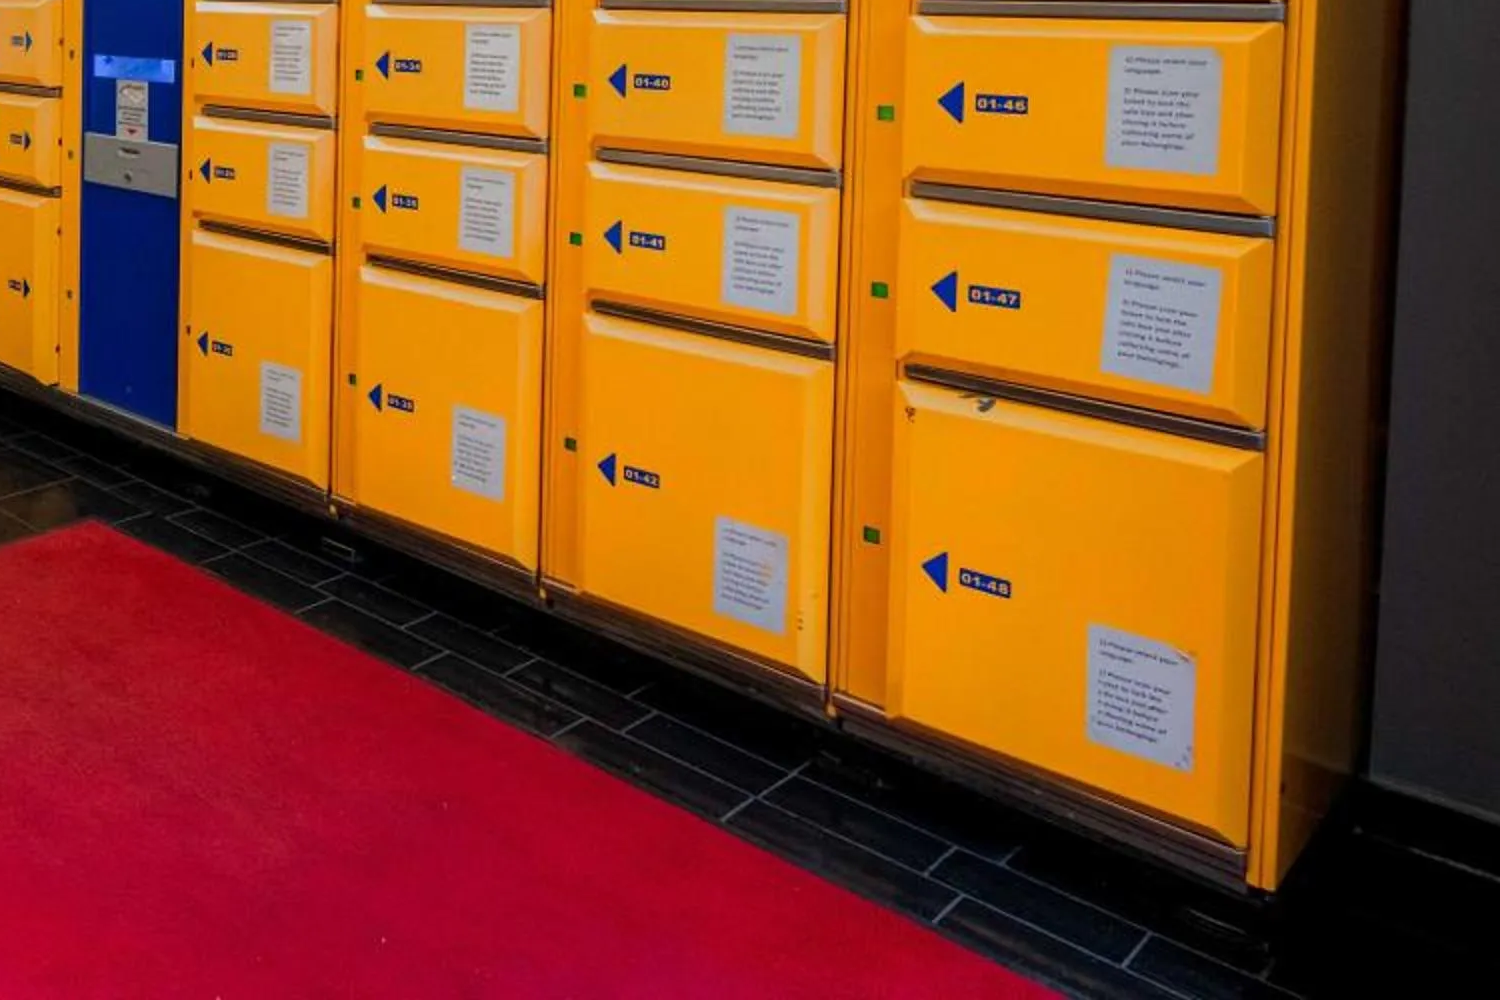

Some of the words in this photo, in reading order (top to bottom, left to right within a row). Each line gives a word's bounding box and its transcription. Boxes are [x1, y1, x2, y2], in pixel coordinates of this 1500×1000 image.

[635, 76, 669, 89] 01-40
[977, 97, 1026, 112] 01-46
[631, 234, 663, 249] 01-41
[971, 288, 1018, 305] 01-47
[625, 469, 658, 485] 01-42
[961, 573, 1008, 595] 01-48
